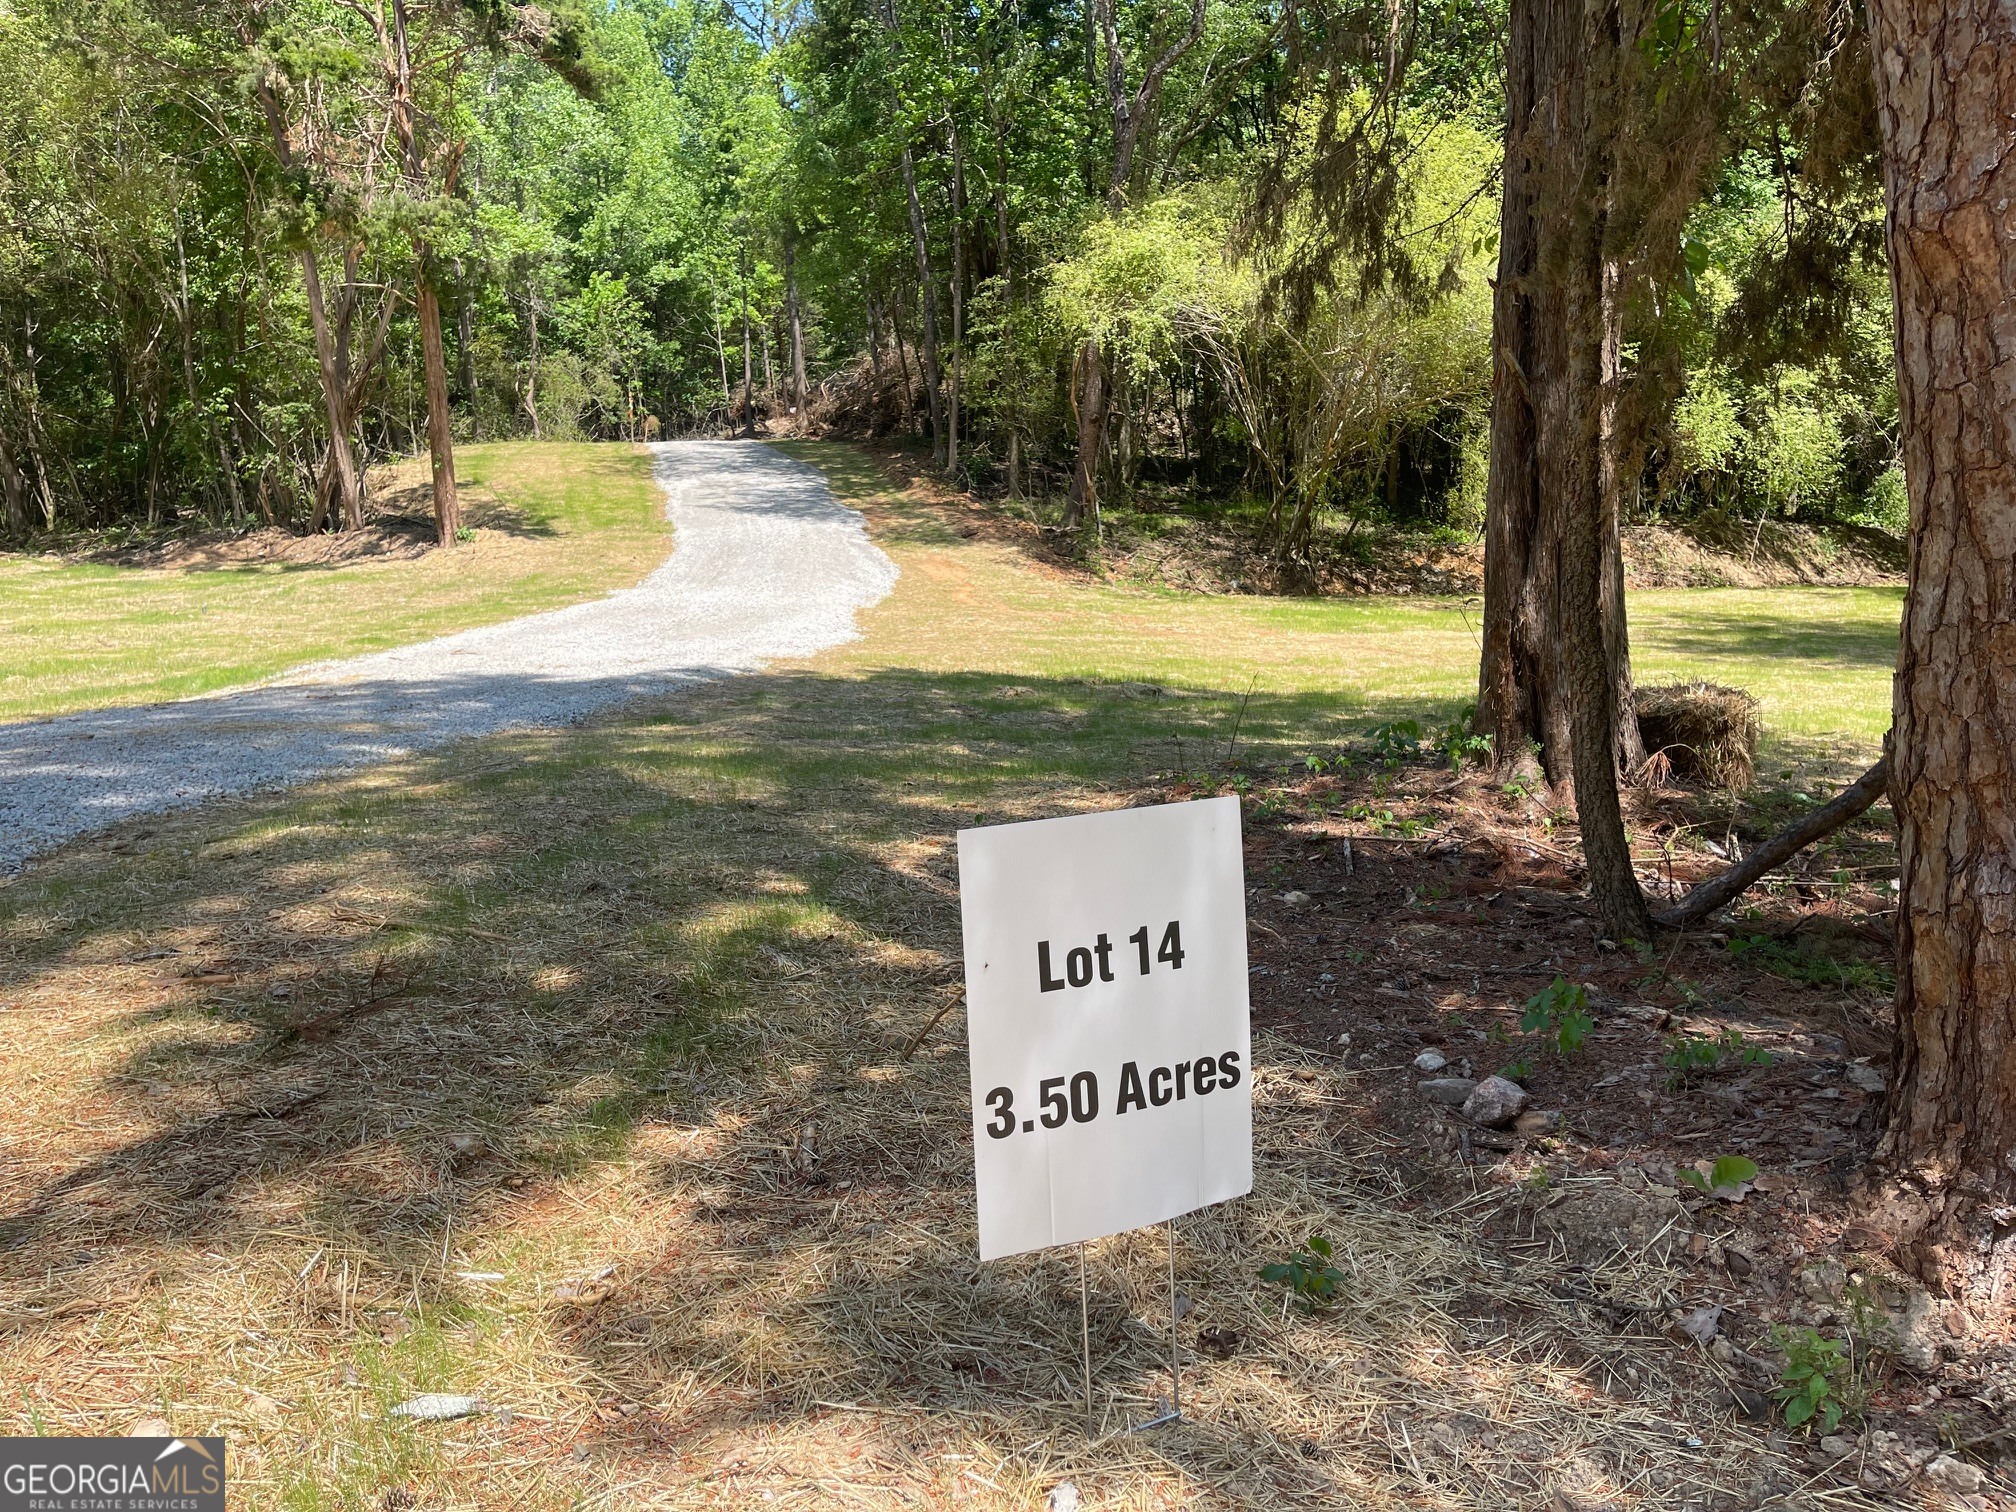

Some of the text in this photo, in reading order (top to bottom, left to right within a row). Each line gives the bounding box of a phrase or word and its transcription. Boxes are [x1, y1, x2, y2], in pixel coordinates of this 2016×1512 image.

[1037, 920, 1186, 994] Lot 14
[985, 1050, 1241, 1140] 3.50 Acres
